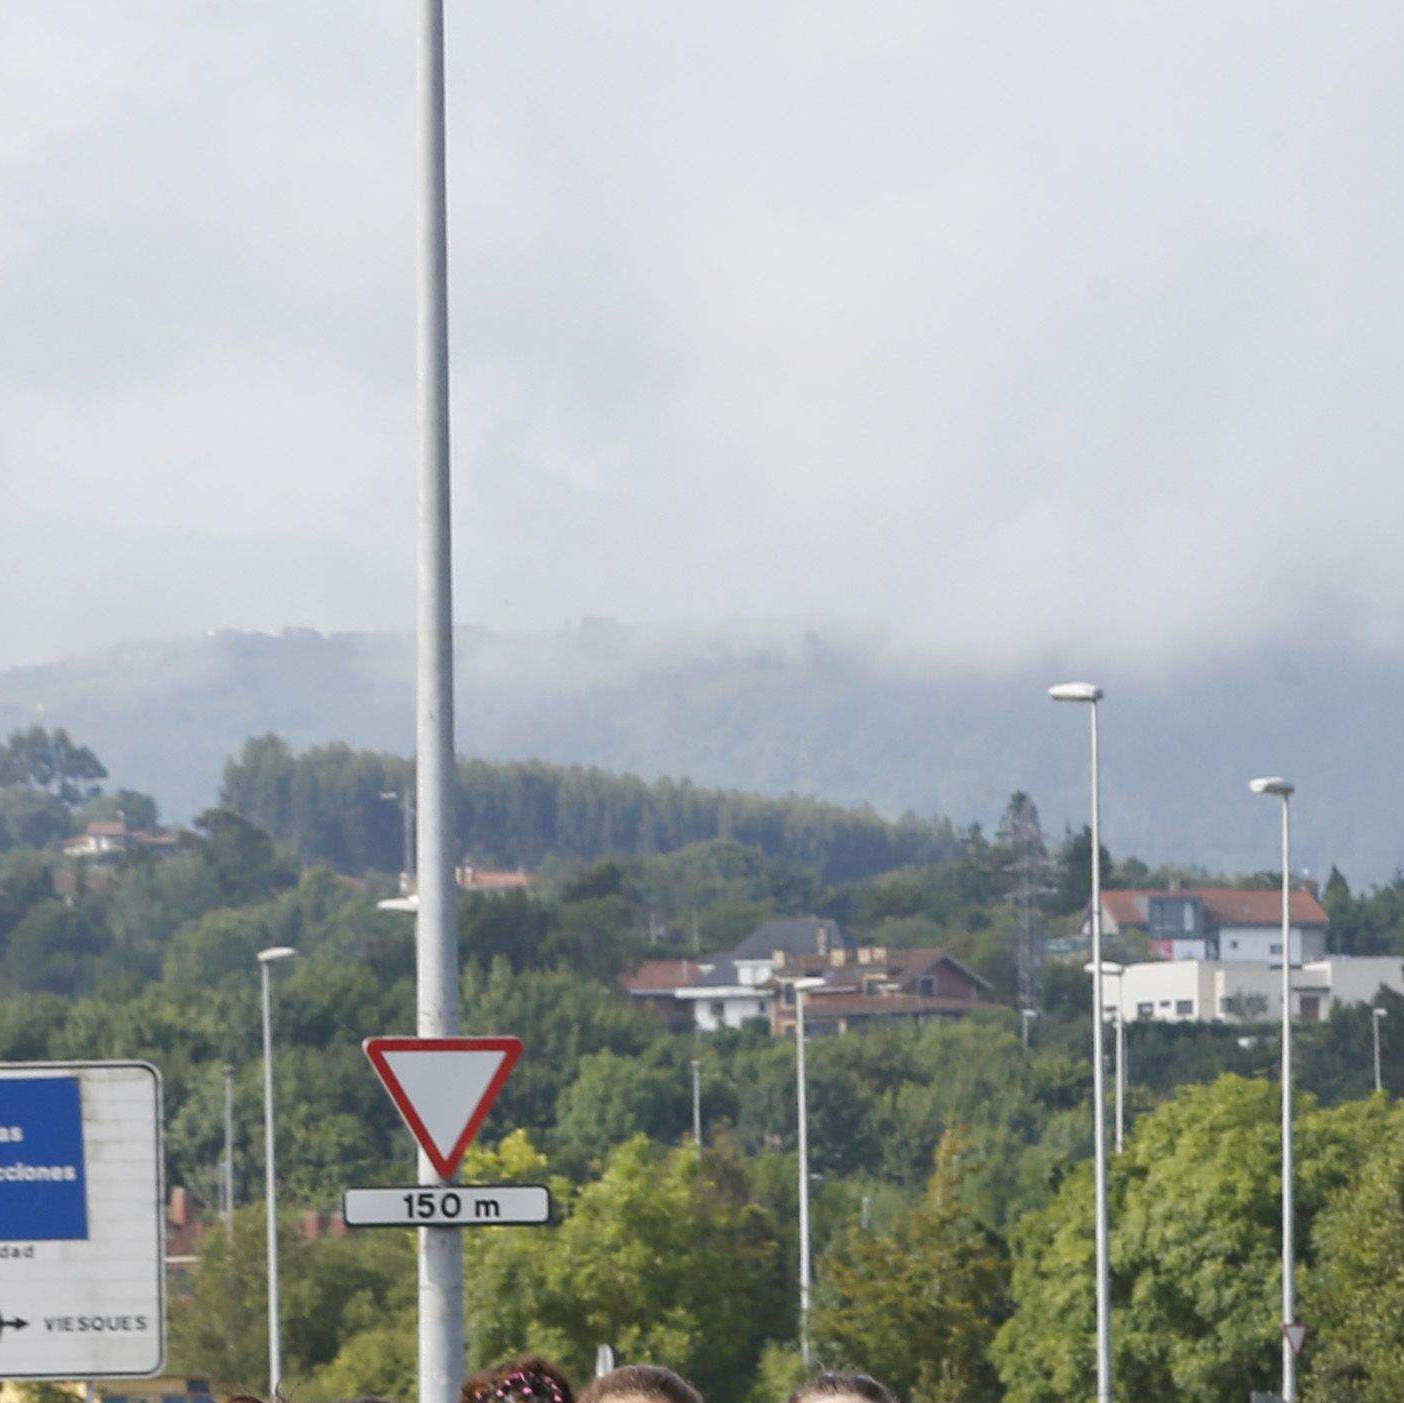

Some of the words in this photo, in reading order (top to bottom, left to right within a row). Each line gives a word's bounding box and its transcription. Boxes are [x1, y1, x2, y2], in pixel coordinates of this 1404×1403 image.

[403, 1193, 462, 1218] 150
[475, 1199, 500, 1218] m
[43, 1315, 148, 1331] VIESQUES
